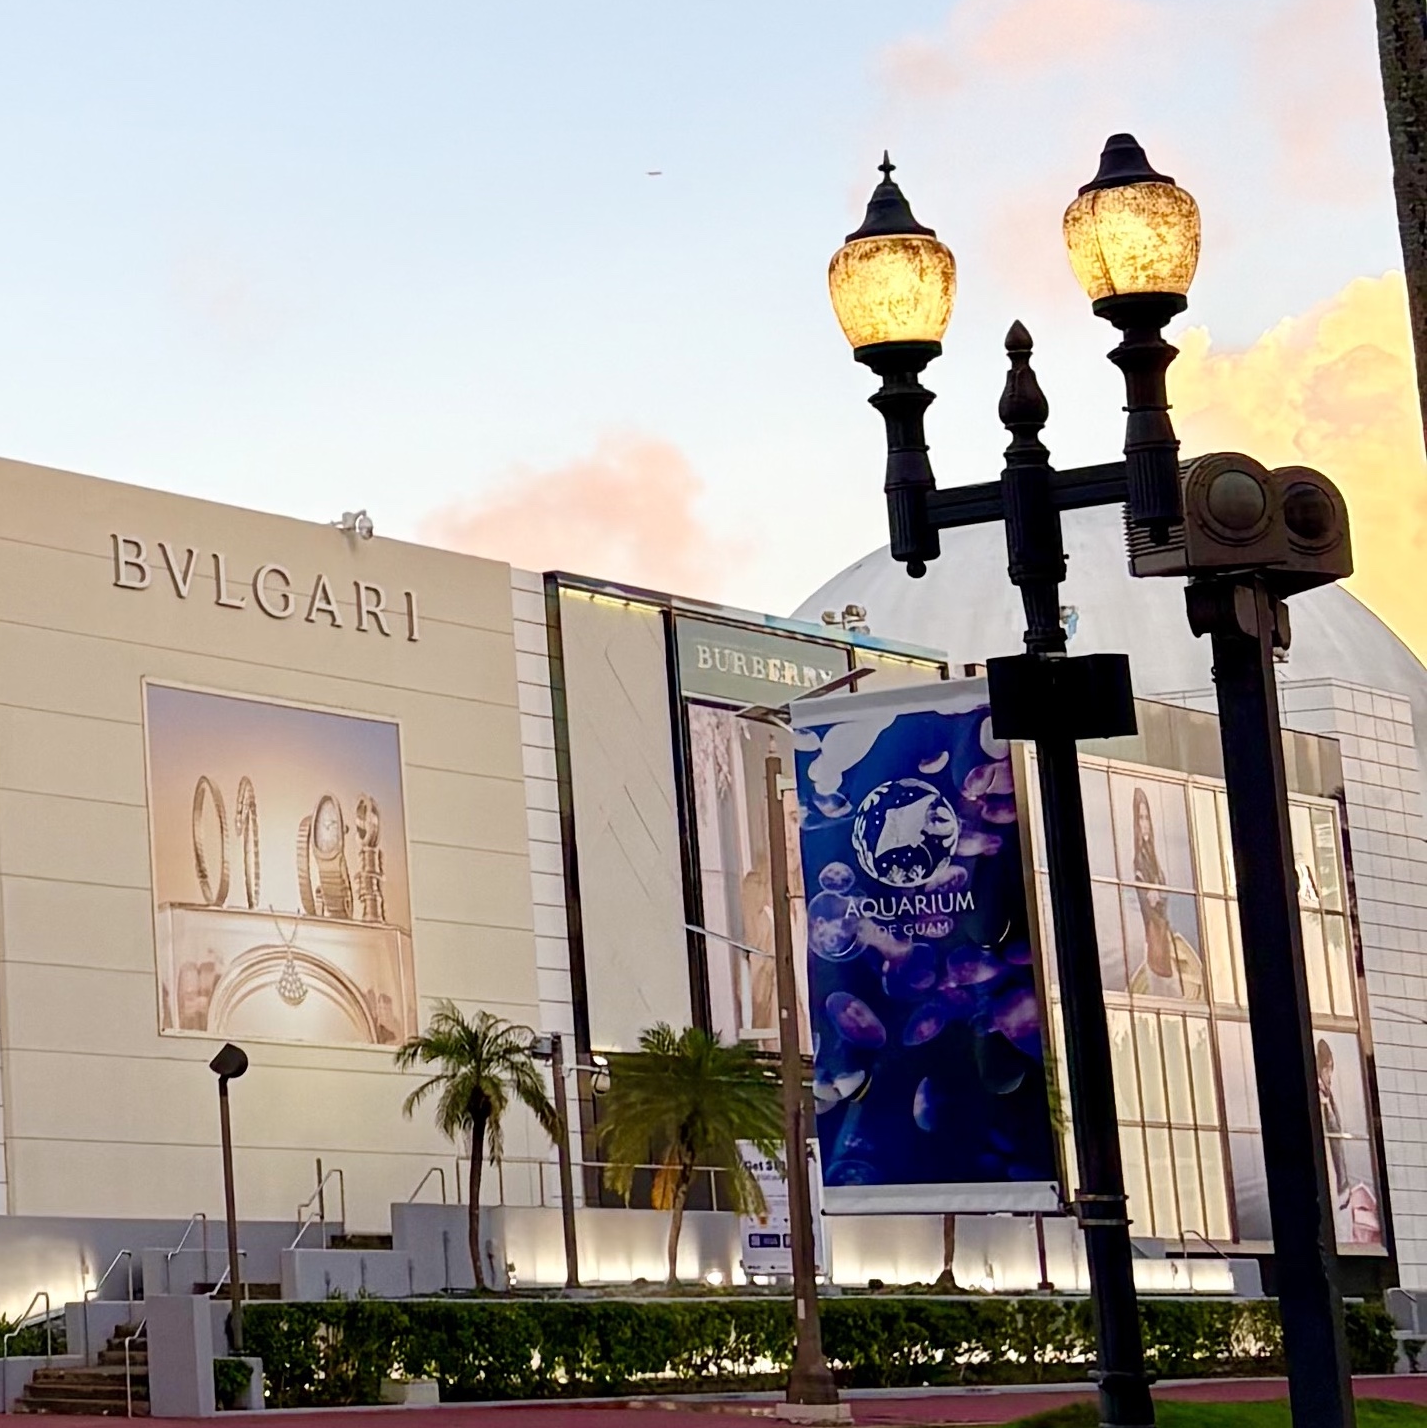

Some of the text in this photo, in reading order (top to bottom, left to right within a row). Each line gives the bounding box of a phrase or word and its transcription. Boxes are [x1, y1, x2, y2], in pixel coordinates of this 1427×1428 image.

[110, 533, 421, 643] BVLGARI
[844, 891, 975, 921] AQUARIUM
[878, 921, 950, 936] OF GUAM
